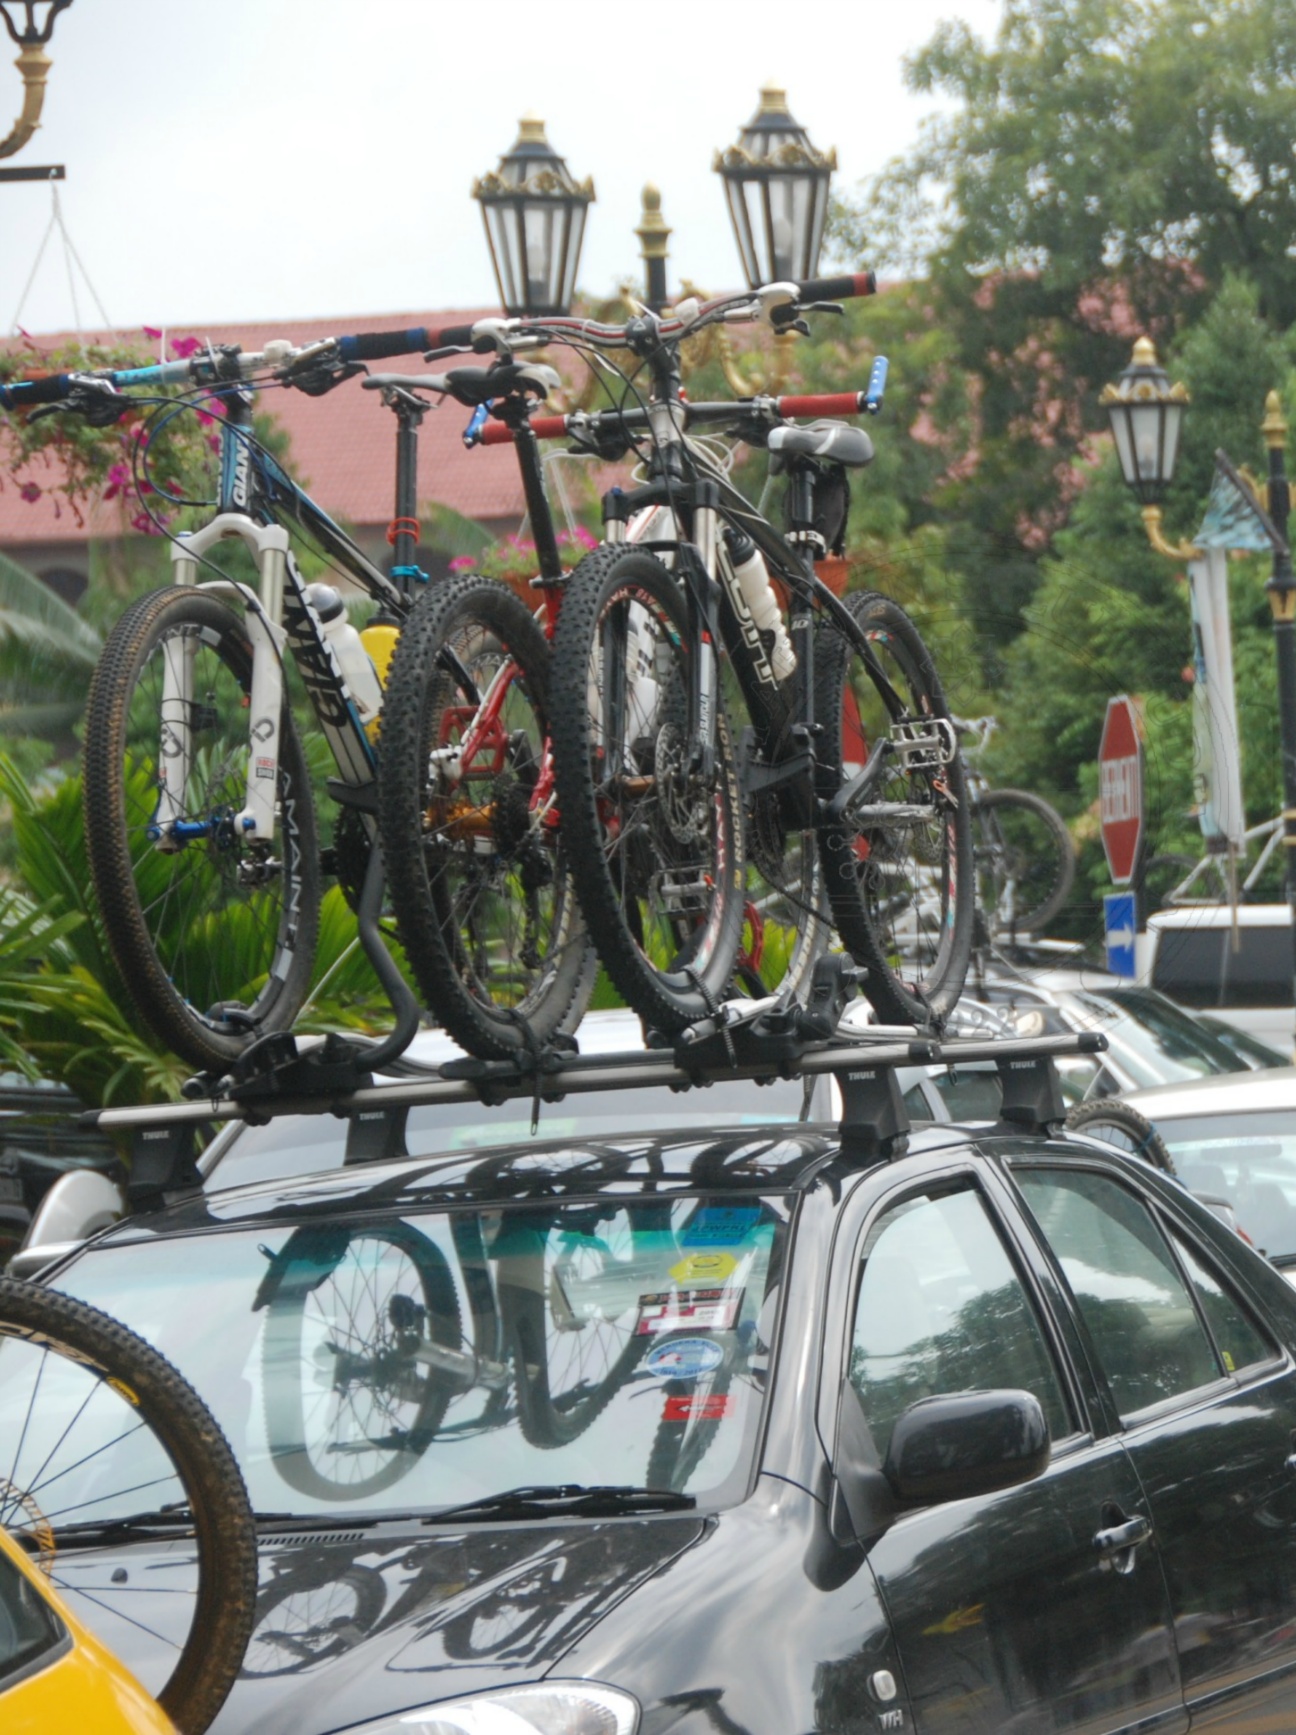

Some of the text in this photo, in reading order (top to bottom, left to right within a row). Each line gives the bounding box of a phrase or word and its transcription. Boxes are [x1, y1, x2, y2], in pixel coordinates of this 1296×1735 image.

[1009, 1060, 1037, 1070] THULE
[848, 1070, 876, 1081] THULE
[358, 1111, 385, 1121] THULE
[142, 1130, 170, 1140] THULE
